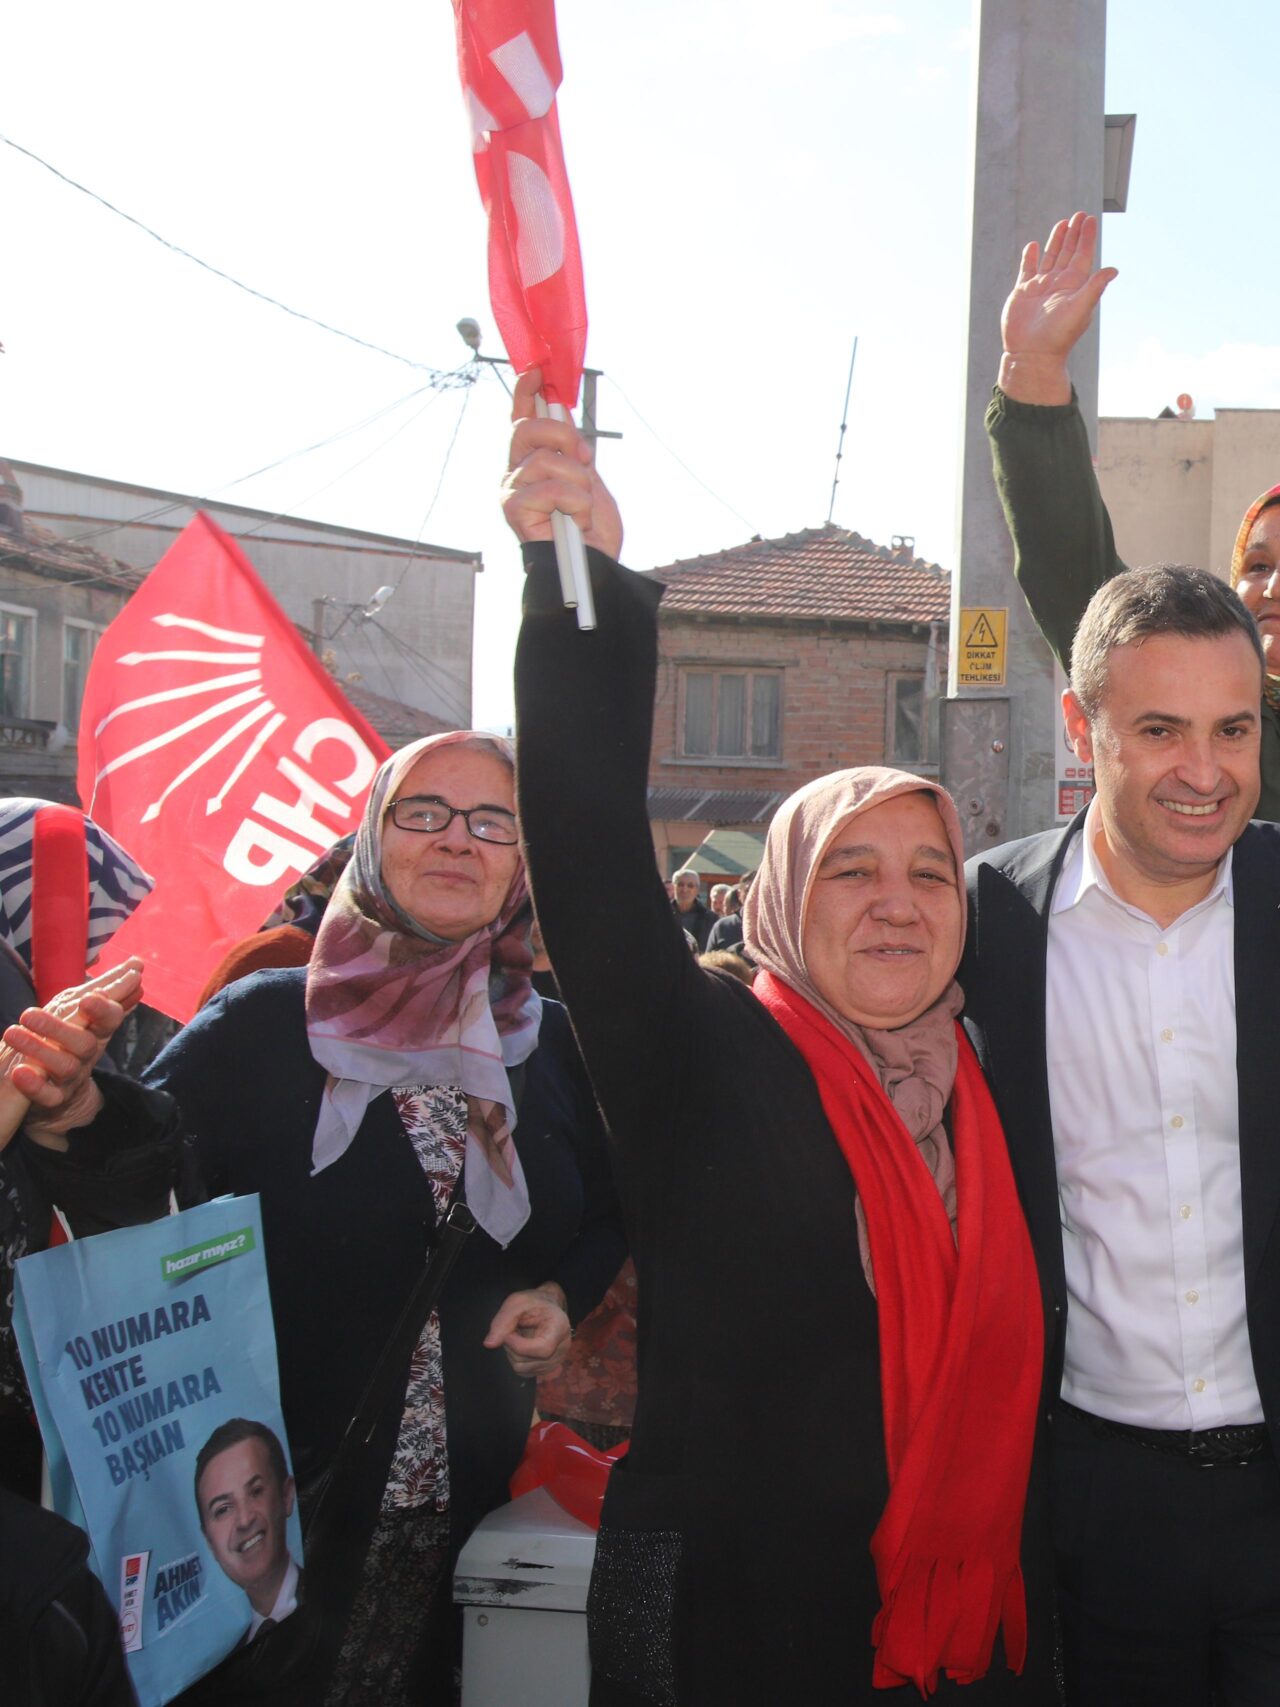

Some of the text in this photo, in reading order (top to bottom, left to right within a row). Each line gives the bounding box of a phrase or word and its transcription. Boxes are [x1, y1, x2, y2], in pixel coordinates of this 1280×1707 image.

[967, 650, 996, 659] DİKKAT
[65, 1294, 212, 1371] 10 NUMARA
[80, 1354, 147, 1411] KENTE
[92, 1366, 222, 1447] 10 NUMARA
[104, 1419, 186, 1487] BAŞKAN
